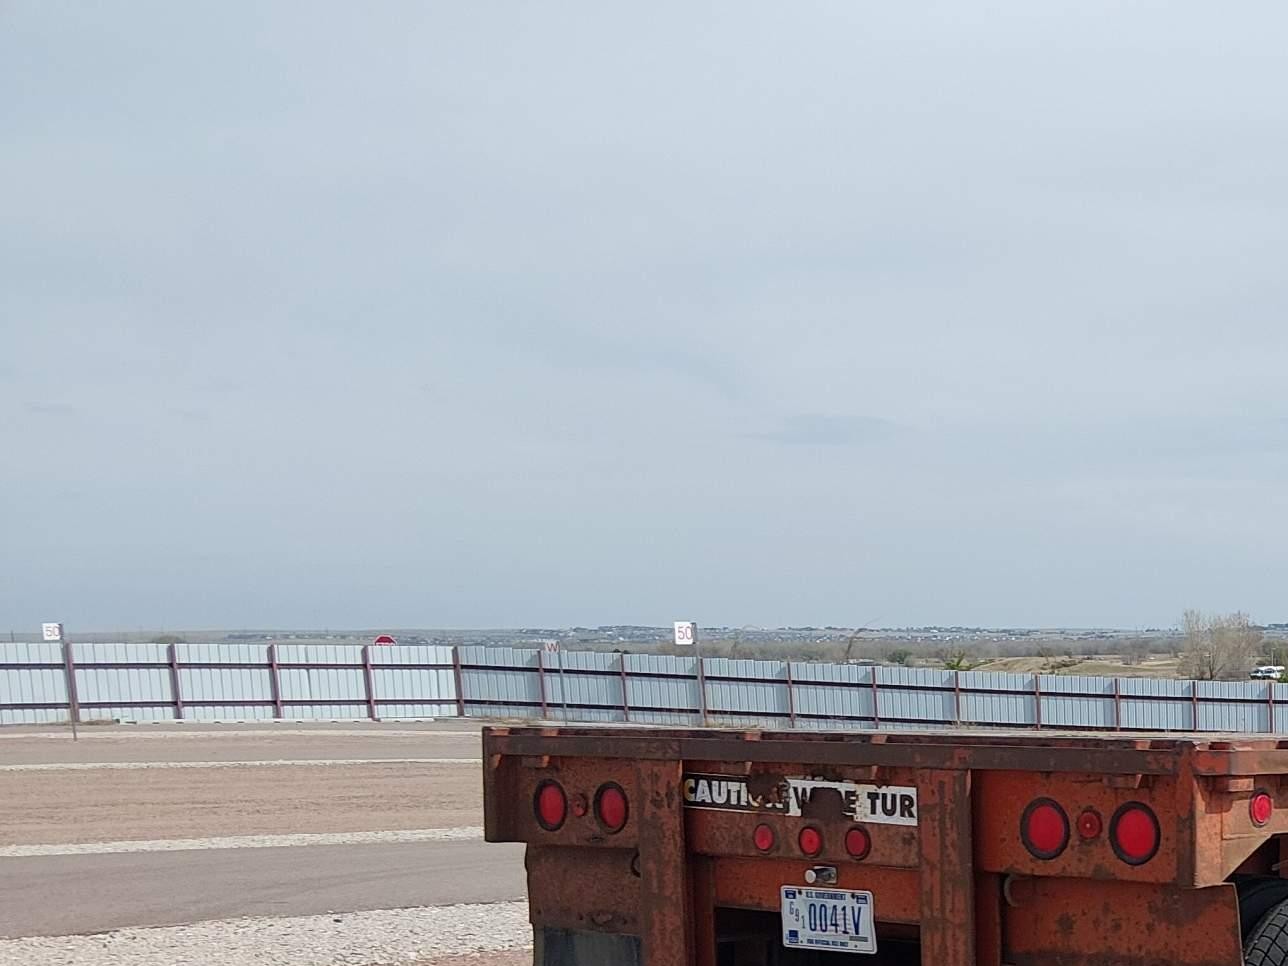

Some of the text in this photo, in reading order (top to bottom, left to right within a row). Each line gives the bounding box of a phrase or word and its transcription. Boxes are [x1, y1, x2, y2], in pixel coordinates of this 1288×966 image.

[678, 626, 692, 639] 50
[684, 778, 784, 808] CAUTI
[791, 785, 857, 816] WE
[808, 903, 862, 936] 0041V
